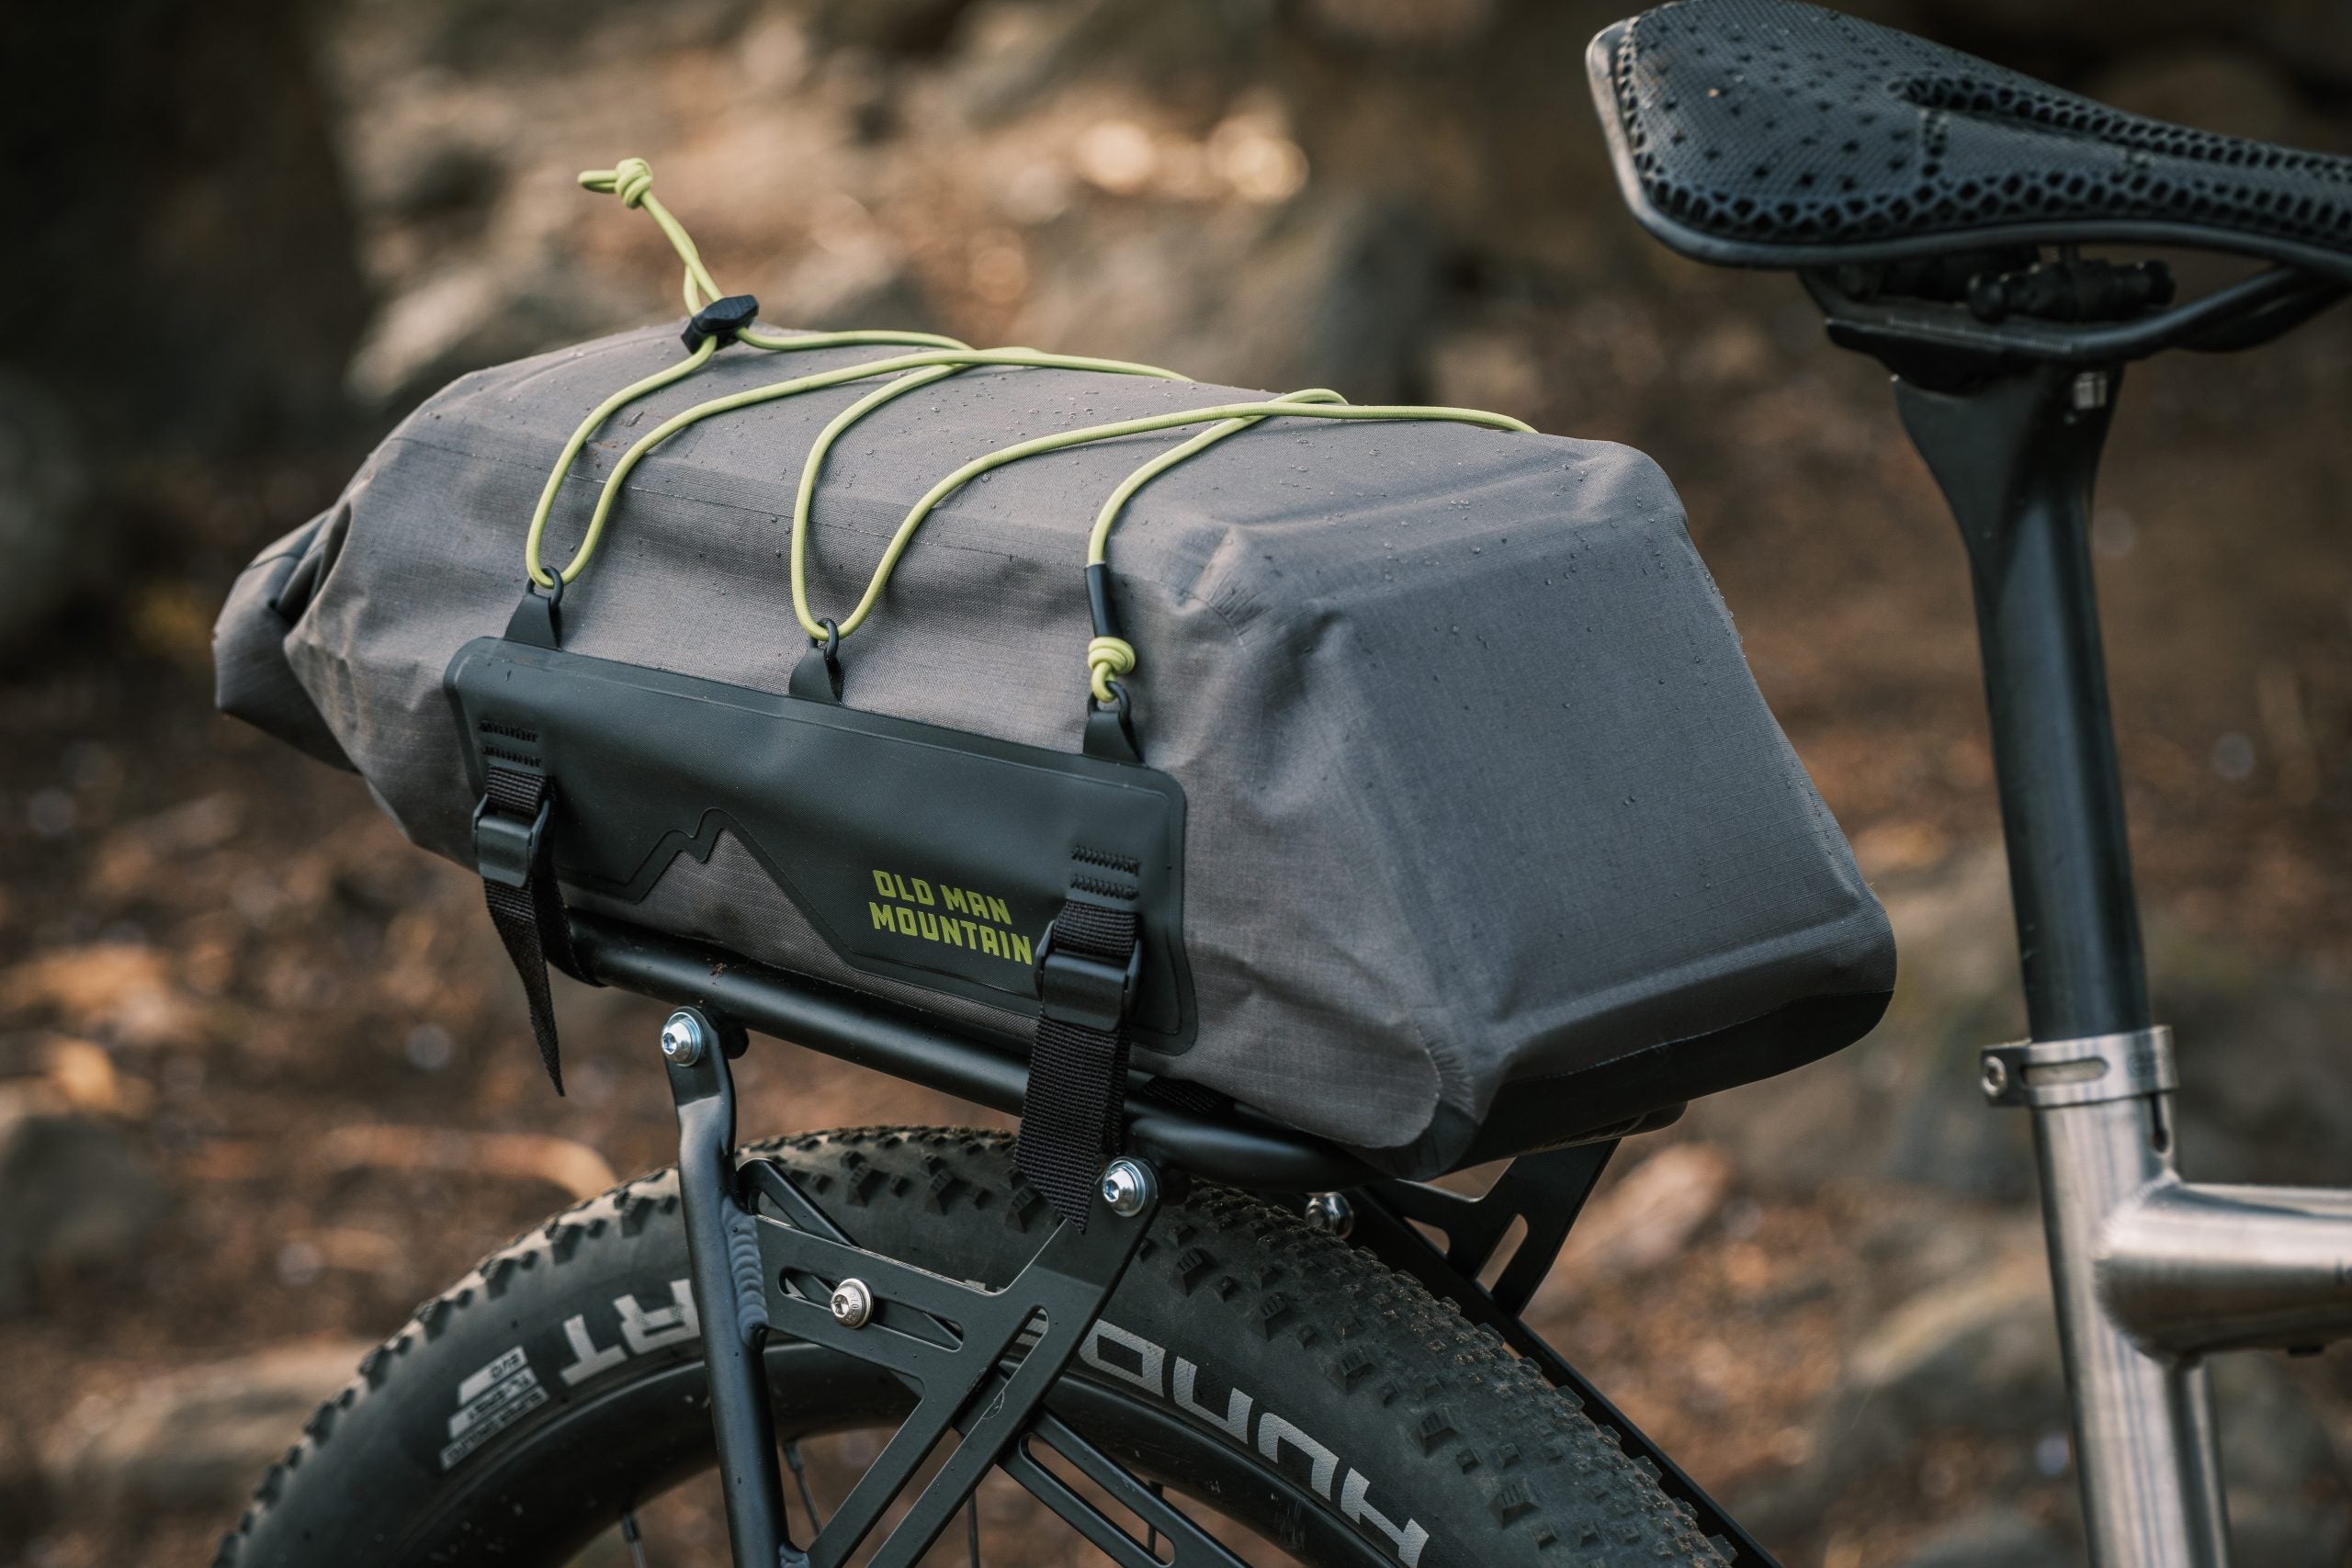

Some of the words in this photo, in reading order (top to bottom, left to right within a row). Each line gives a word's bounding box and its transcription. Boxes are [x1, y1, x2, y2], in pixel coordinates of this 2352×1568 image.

[873, 869, 935, 906] OLD
[940, 884, 1012, 925] MAN
[869, 901, 1033, 965] MOUNTAIN
